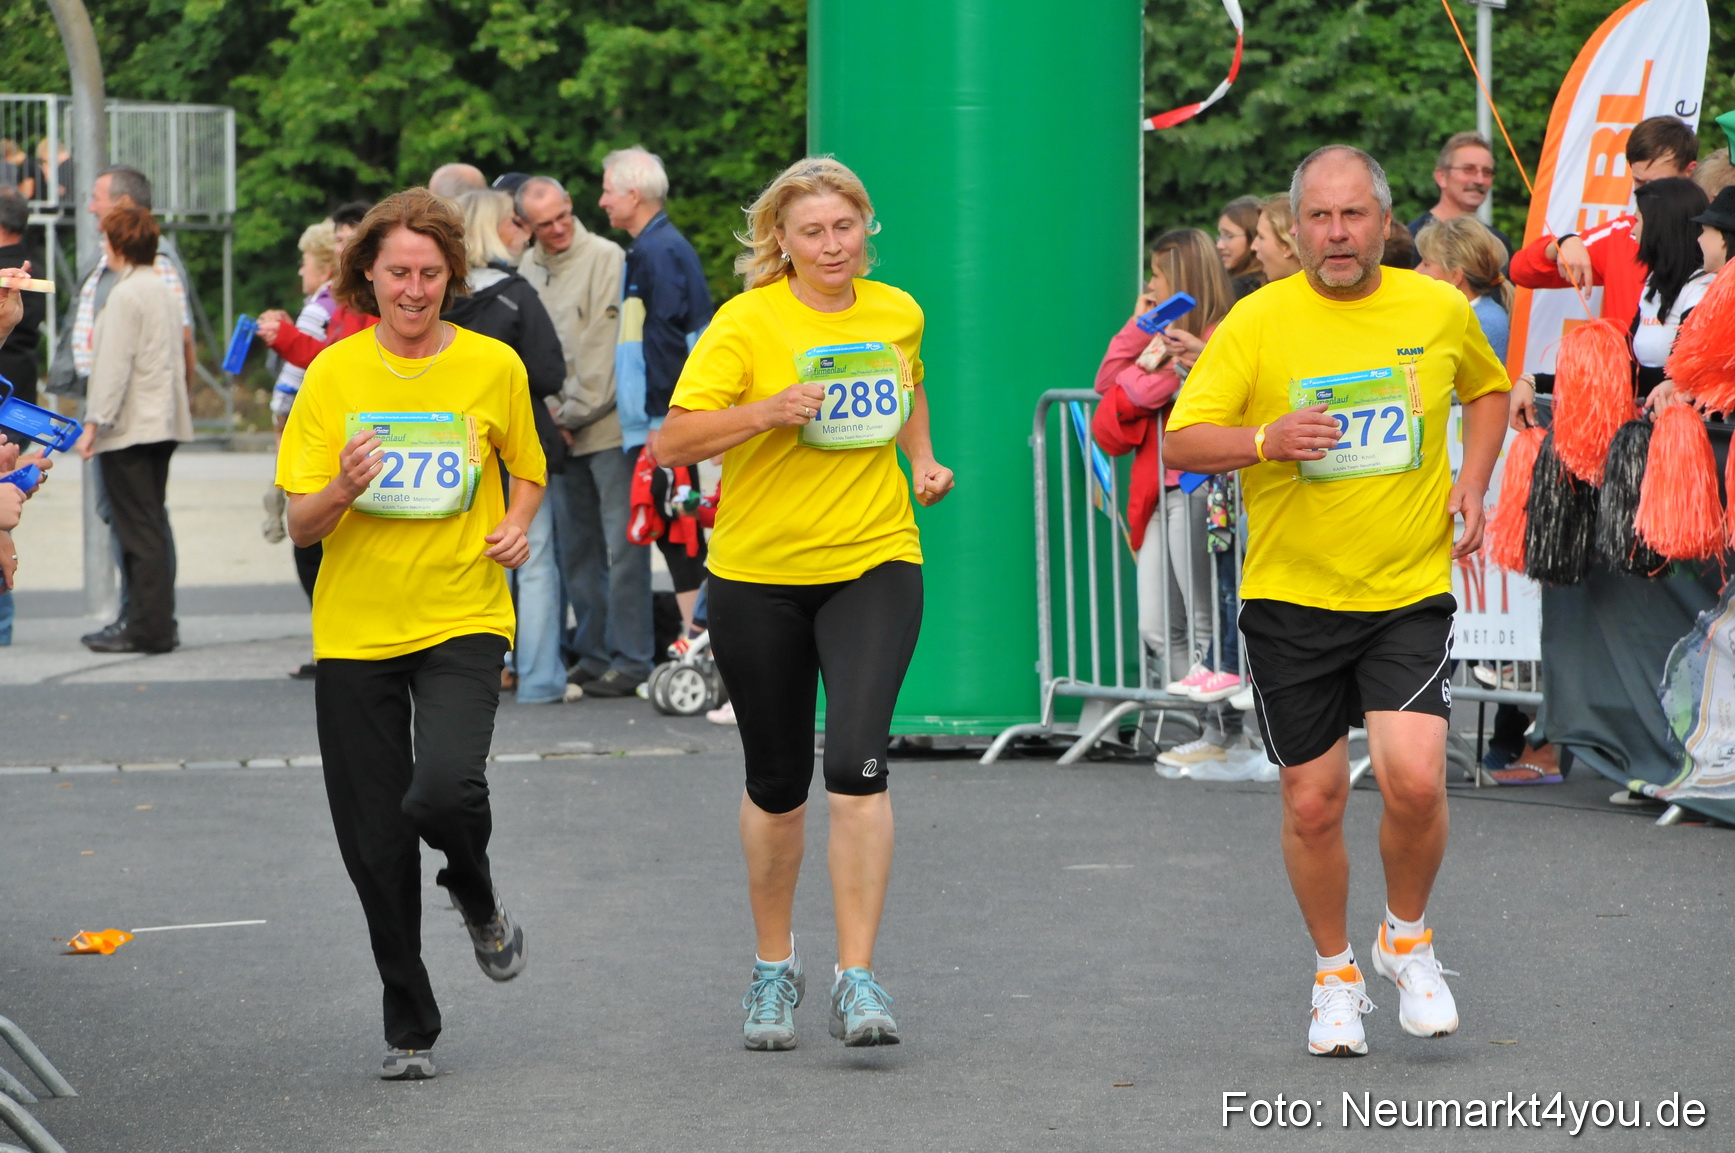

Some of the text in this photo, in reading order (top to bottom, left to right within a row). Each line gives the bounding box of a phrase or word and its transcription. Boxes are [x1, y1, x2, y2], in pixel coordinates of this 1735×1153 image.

[1397, 347, 1424, 356] KANN
[822, 424, 864, 434] Marianne
[1312, 406, 1407, 452] 272
[1336, 453, 1358, 463] Otto
[367, 451, 461, 489] 278
[373, 492, 411, 502] Renate
